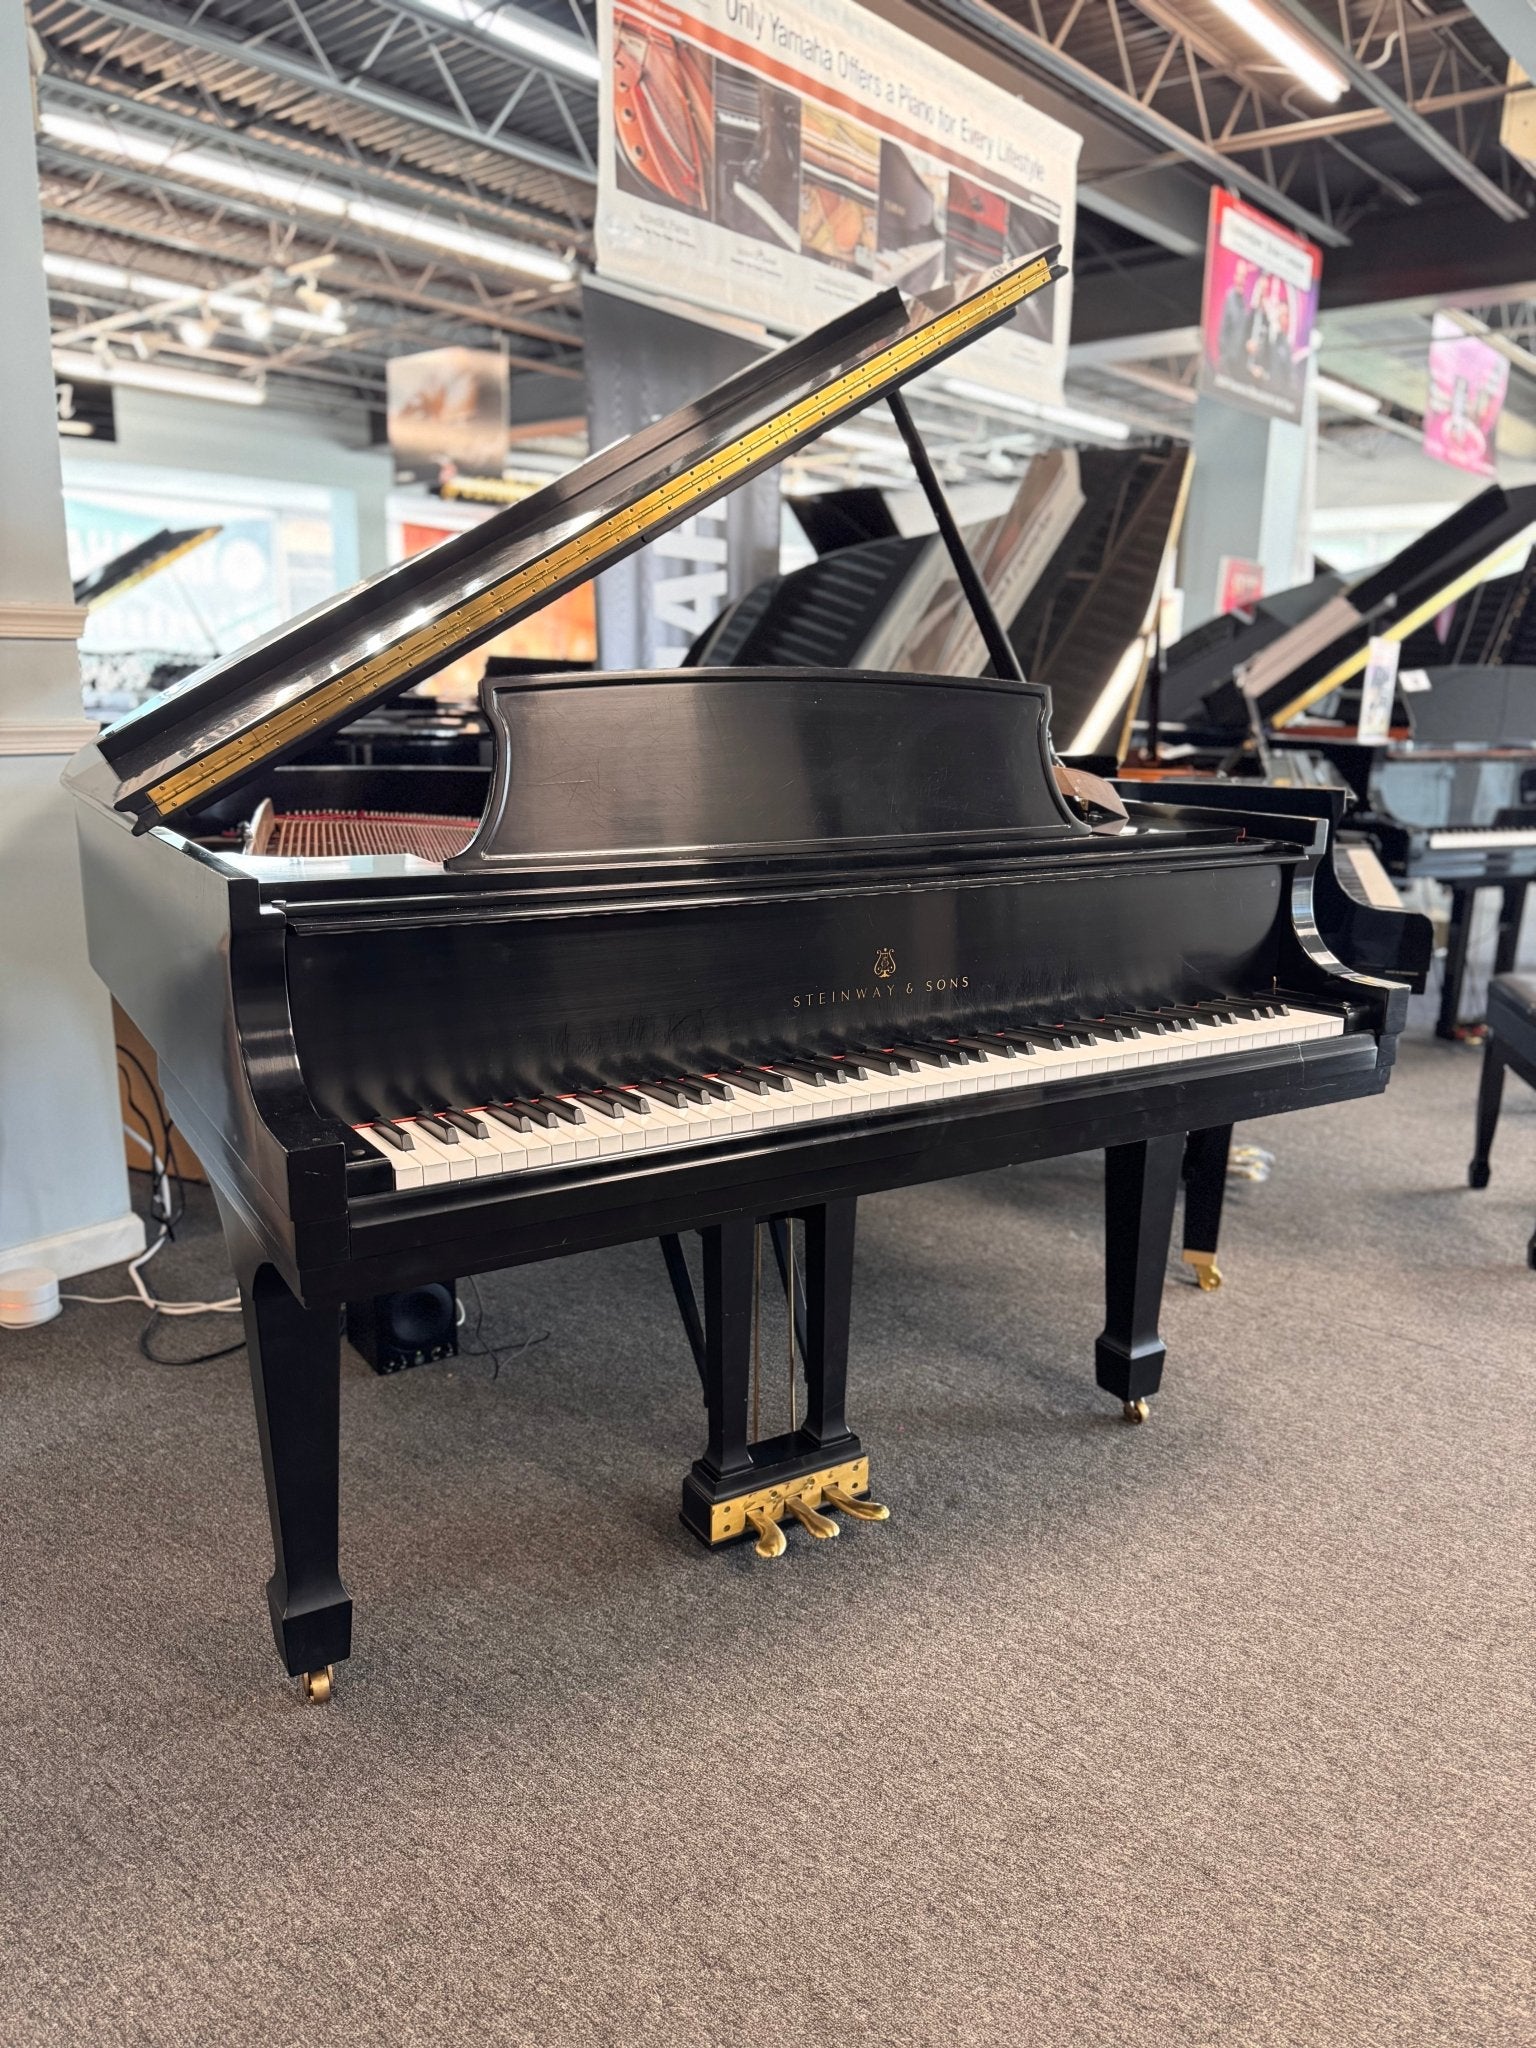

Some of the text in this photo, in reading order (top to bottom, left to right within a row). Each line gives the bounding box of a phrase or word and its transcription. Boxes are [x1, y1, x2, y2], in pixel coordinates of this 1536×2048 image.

[726, 0, 764, 40] Only
[769, 12, 832, 71] Yamaha
[838, 50, 881, 98] Offers
[885, 82, 894, 103] a
[898, 83, 935, 125] Piano
[938, 106, 956, 133] for
[959, 117, 994, 161] Every
[997, 138, 1046, 182] Lifestyle
[793, 976, 969, 1008] STEINWAY & SONS
